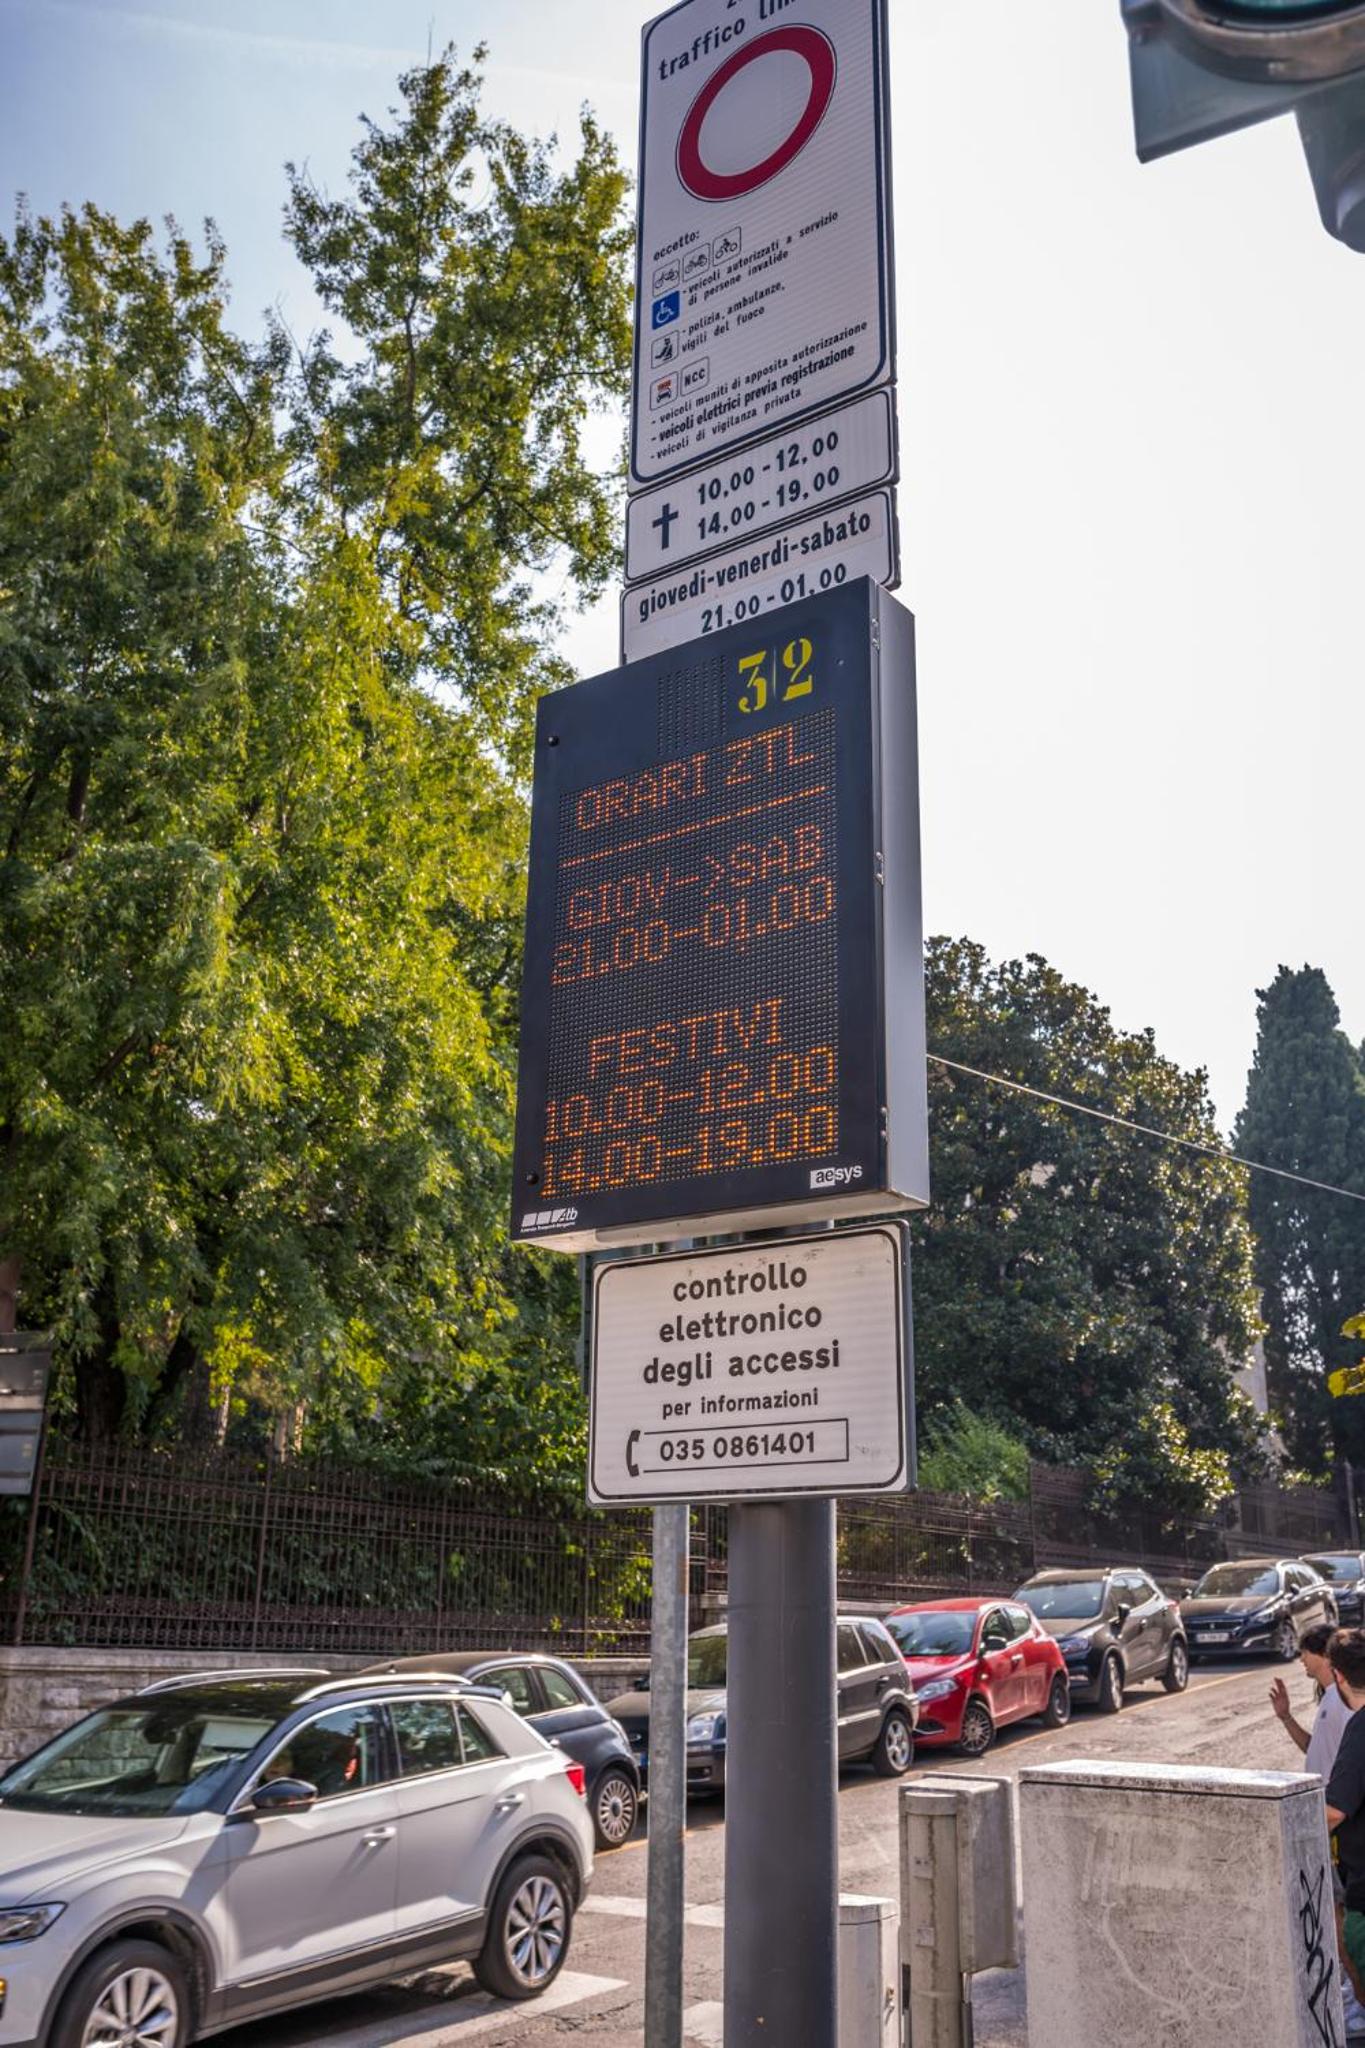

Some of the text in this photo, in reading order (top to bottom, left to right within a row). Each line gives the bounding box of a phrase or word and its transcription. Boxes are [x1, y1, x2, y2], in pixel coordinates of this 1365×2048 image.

[658, 18, 745, 81] traffico
[653, 230, 700, 261] eccetto:
[726, 240, 779, 275] autorizzati
[786, 236, 793, 244] a
[799, 211, 838, 238] servizio
[688, 295, 698, 306] di
[704, 274, 741, 300] persone
[682, 306, 765, 352] vigili del fuoco
[659, 414, 694, 441] veicoli
[697, 393, 740, 425] elettrici
[744, 378, 777, 407] previa
[781, 345, 855, 387] registrazione
[660, 401, 692, 423] veicoli
[696, 382, 728, 407] muniti
[731, 376, 741, 390] di
[745, 358, 788, 384] apposita
[792, 321, 867, 362] autorizzazione
[684, 368, 705, 387] NCC
[696, 429, 705, 442] di
[712, 408, 757, 435] vigilanza
[764, 388, 801, 414] privata
[576, 725, 815, 831] ORARI ZTL
[588, 998, 783, 1080] FESTIVI
[812, 1165, 862, 1185] aesys
[673, 1262, 807, 1301] controllo
[659, 1303, 822, 1342] elettronico
[643, 1339, 840, 1386] degli accessi
[662, 1388, 818, 1420] per informazioni
[660, 1431, 815, 1462] 035 0861401
